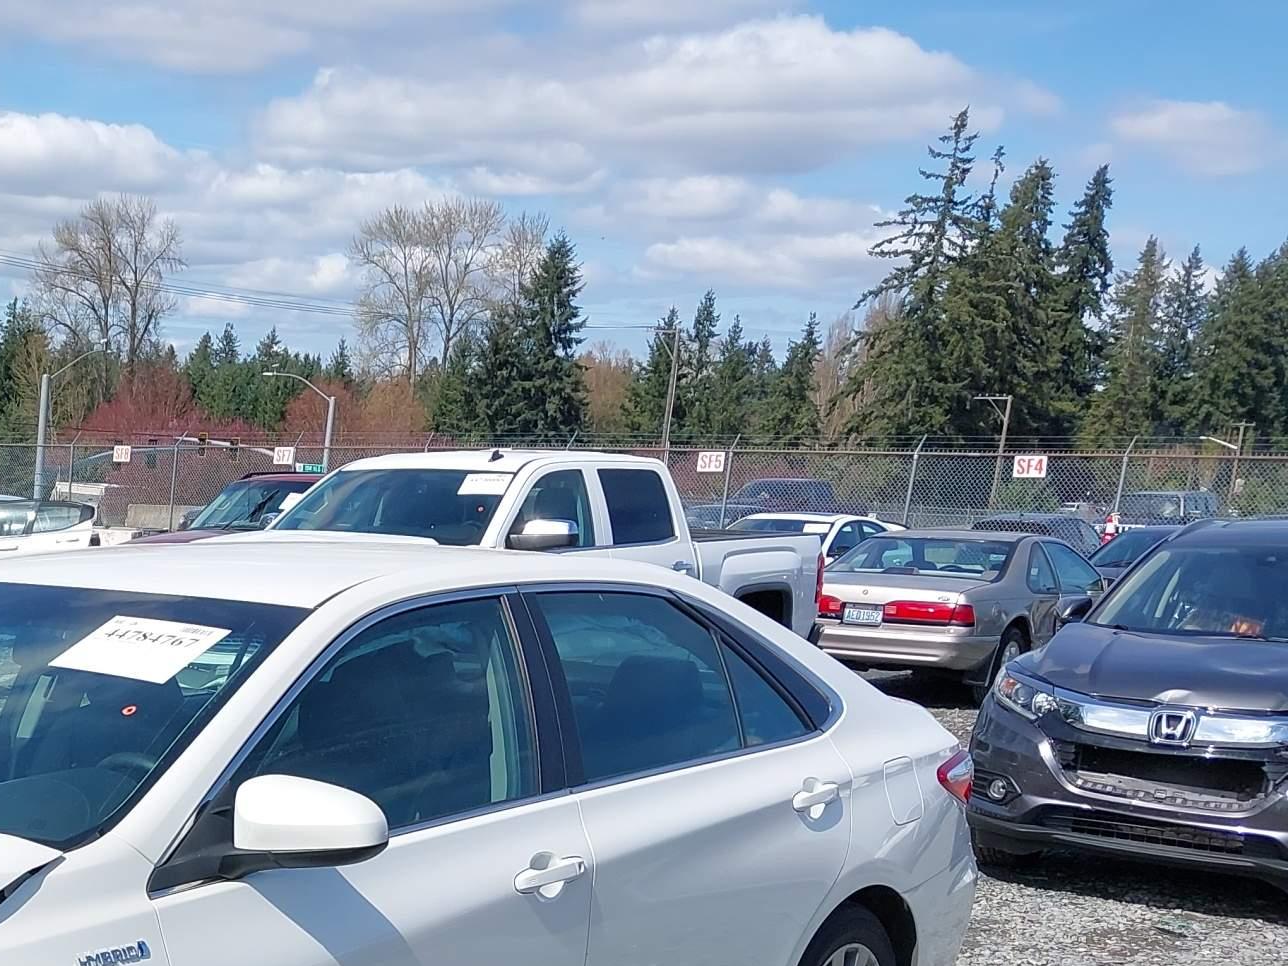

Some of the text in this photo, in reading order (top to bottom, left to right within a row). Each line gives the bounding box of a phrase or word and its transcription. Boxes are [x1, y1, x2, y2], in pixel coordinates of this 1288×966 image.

[115, 447, 130, 460] SF8
[276, 449, 292, 463] SF7
[700, 454, 723, 469] SF5
[1016, 458, 1044, 475] SF4
[104, 628, 200, 648] 44784767
